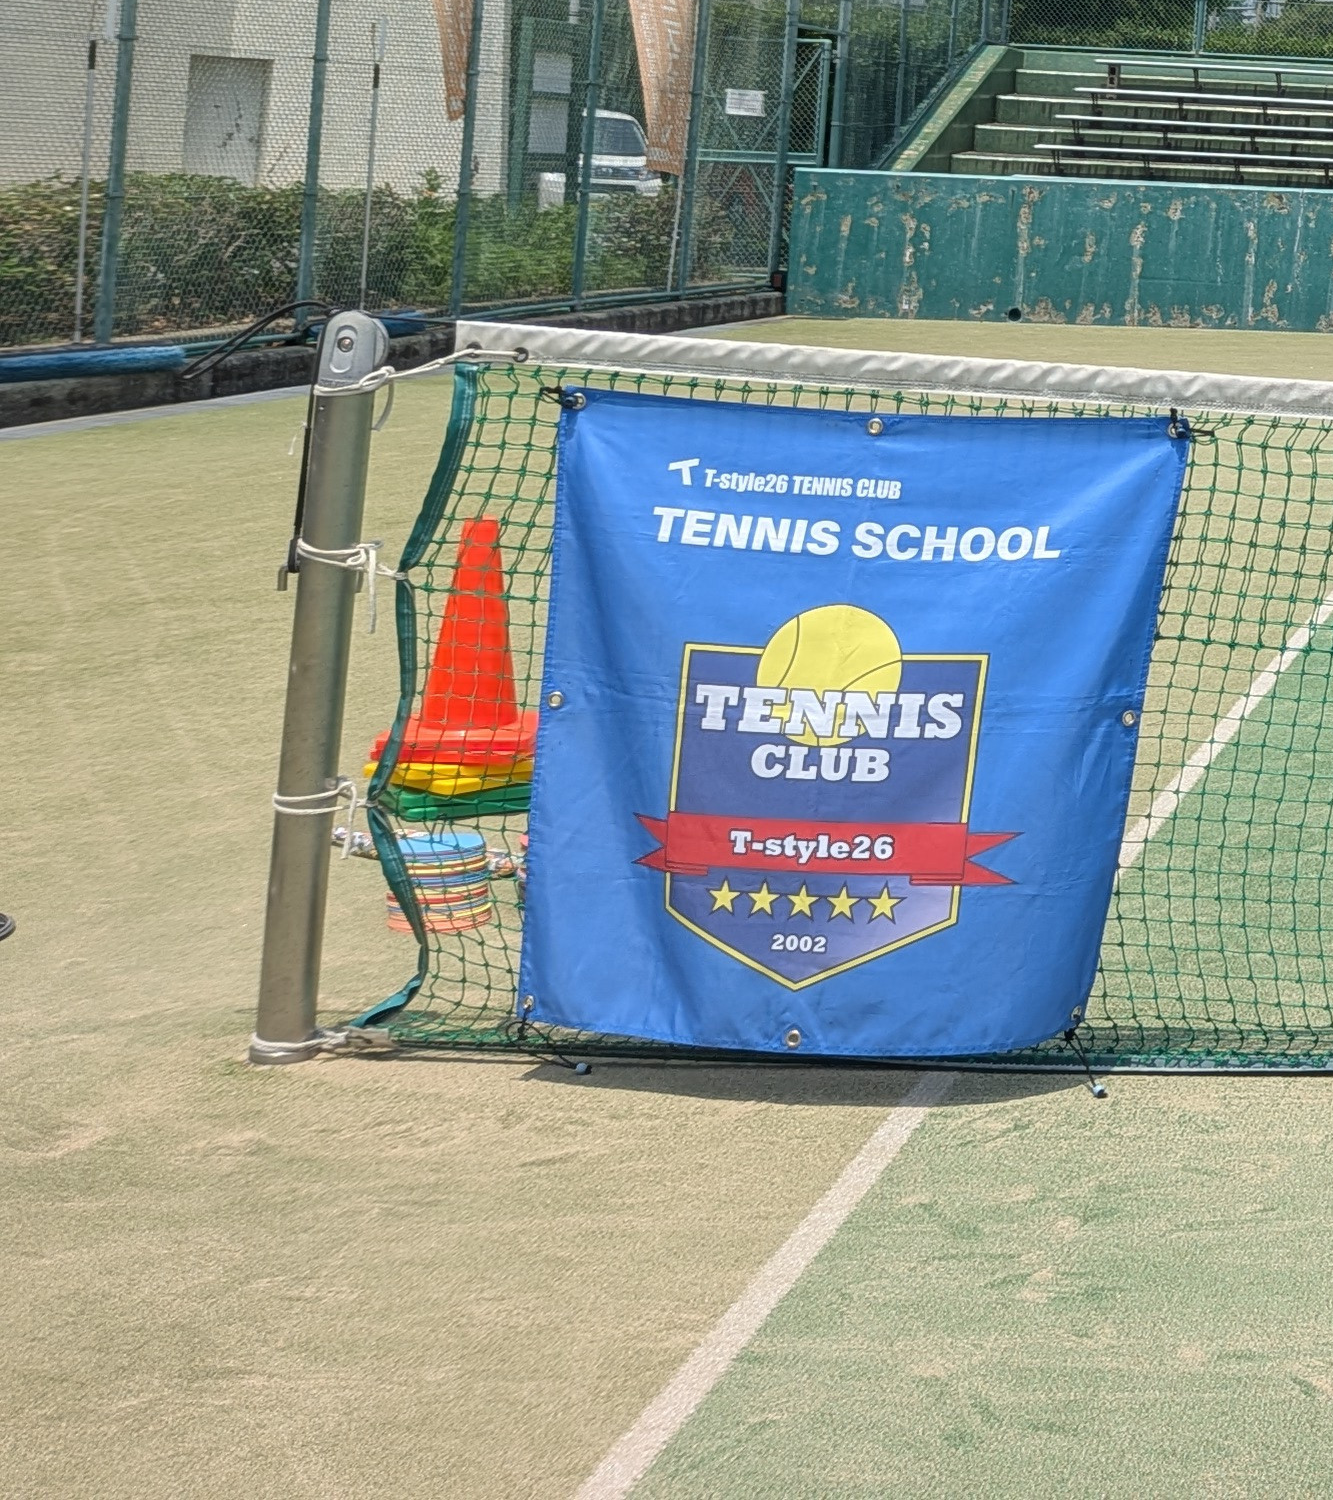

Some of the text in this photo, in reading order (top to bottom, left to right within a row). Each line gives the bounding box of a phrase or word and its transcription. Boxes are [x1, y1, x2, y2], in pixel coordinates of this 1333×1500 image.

[704, 468, 789, 494] T-style26
[792, 475, 854, 498] TENNIS
[855, 478, 902, 500] CLUB
[652, 506, 1062, 563] TENNIS SCHOOL
[695, 683, 964, 740] TENNIS
[750, 743, 891, 783] CLUB
[729, 829, 893, 864] T-style26
[770, 933, 827, 953] 2002
